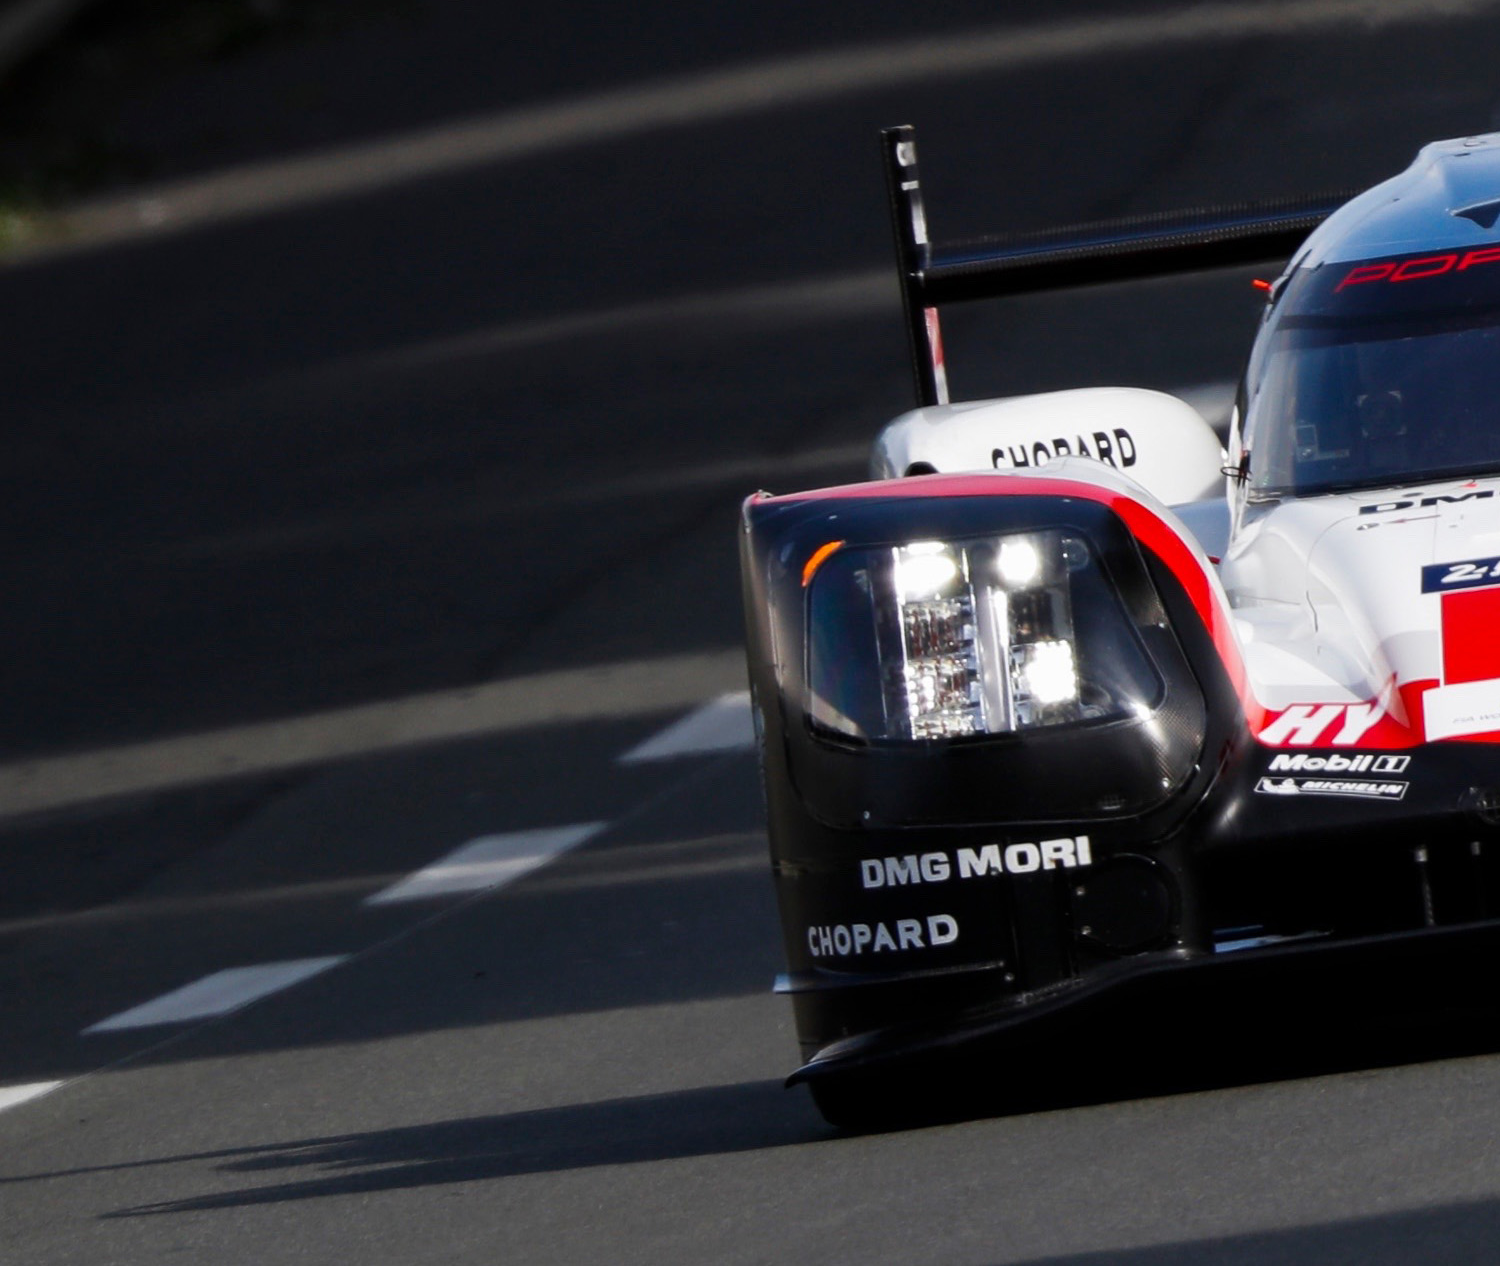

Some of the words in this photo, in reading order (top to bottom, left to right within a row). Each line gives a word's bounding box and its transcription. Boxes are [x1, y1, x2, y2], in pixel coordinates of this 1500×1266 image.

[1257, 703, 1388, 745] HY
[1268, 754, 1374, 772] Mobil
[1301, 781, 1403, 794] MICHELIN
[861, 851, 951, 889] DMG
[956, 835, 1093, 880] MORI
[807, 913, 959, 958] CHOPARD
